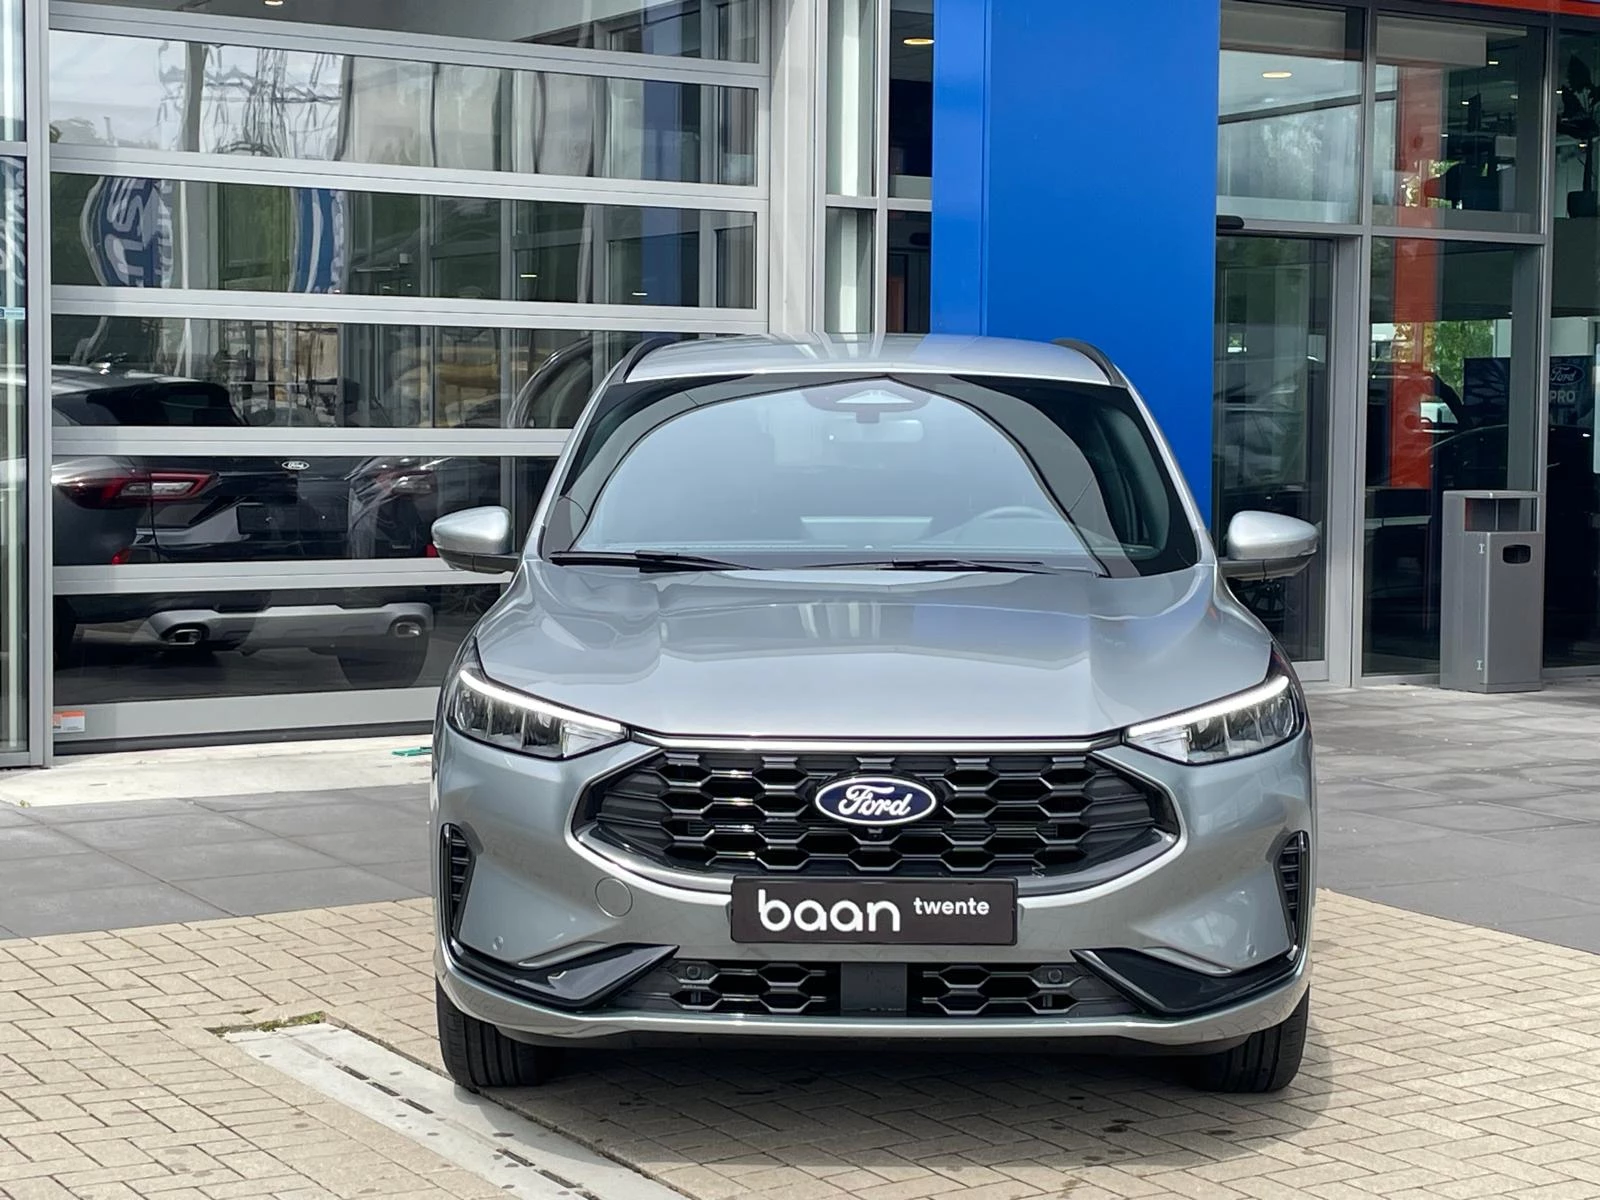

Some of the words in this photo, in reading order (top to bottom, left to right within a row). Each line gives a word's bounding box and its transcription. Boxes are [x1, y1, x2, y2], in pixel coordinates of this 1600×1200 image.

[1549, 390, 1576, 404] PRO
[838, 785, 913, 816] Ford
[758, 889, 900, 932] baan
[913, 897, 990, 915] twente
